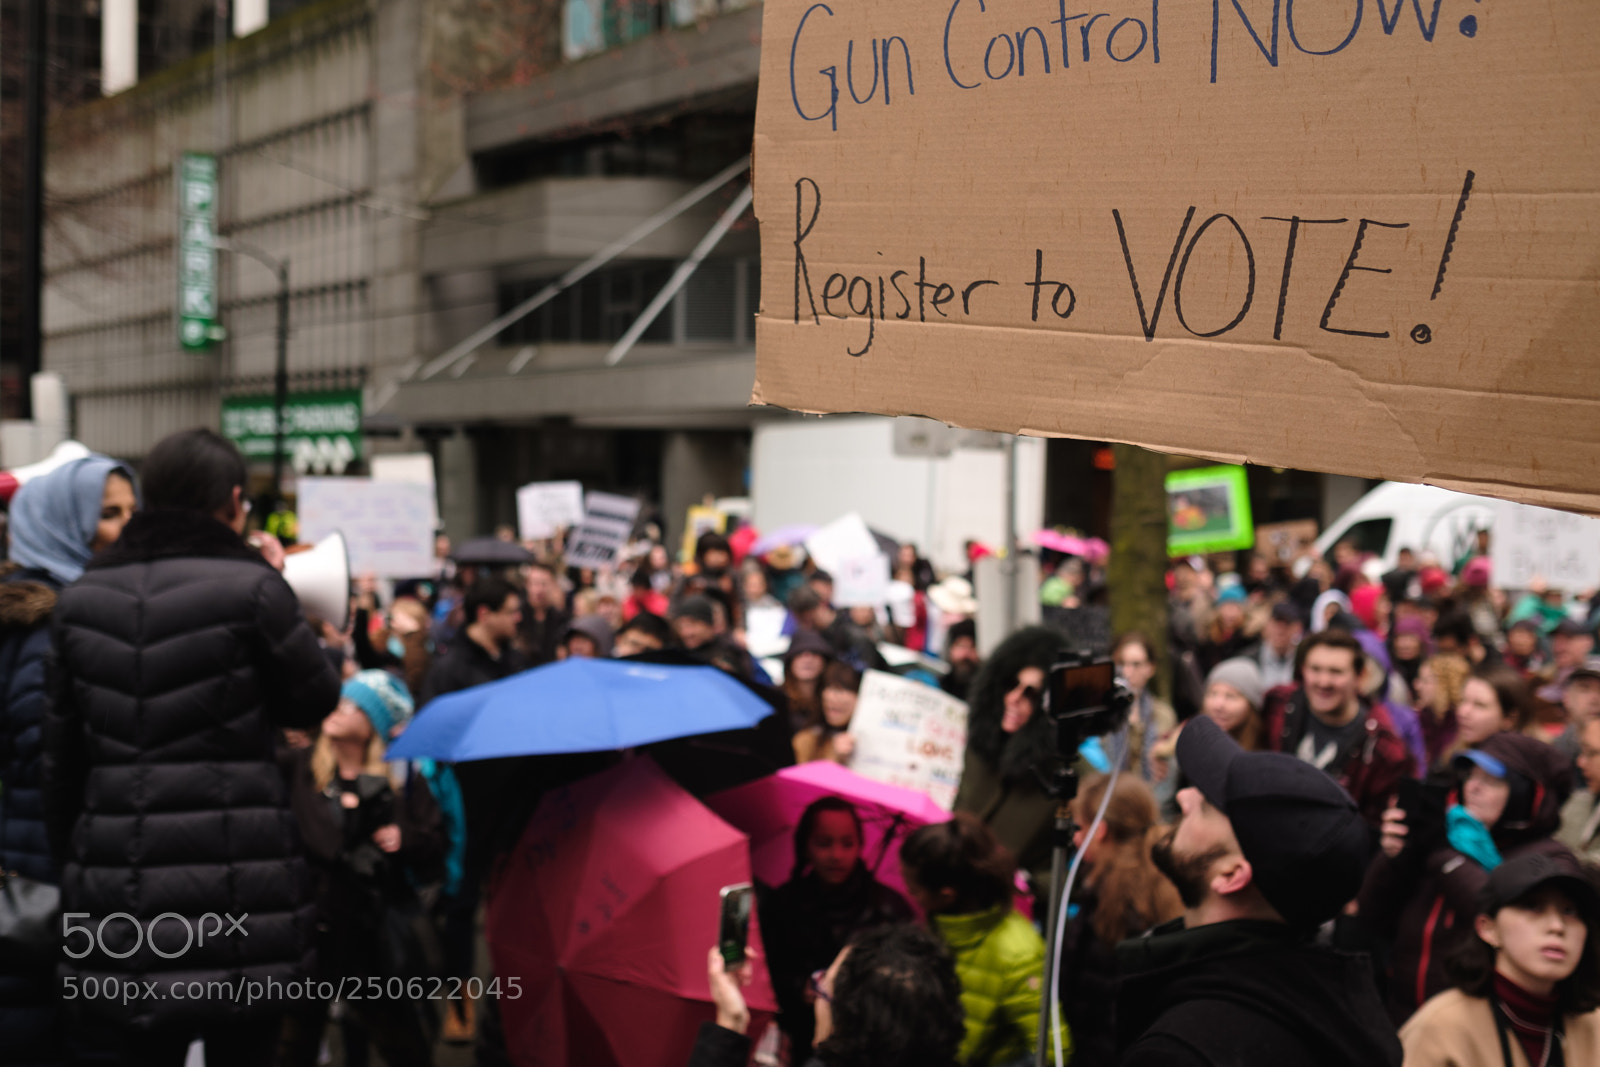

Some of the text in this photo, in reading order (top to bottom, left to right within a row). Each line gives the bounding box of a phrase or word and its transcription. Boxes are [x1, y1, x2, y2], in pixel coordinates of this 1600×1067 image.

[791, 0, 1480, 131] Gun Control NOW
[793, 169, 1476, 357] Register to VOTE!
